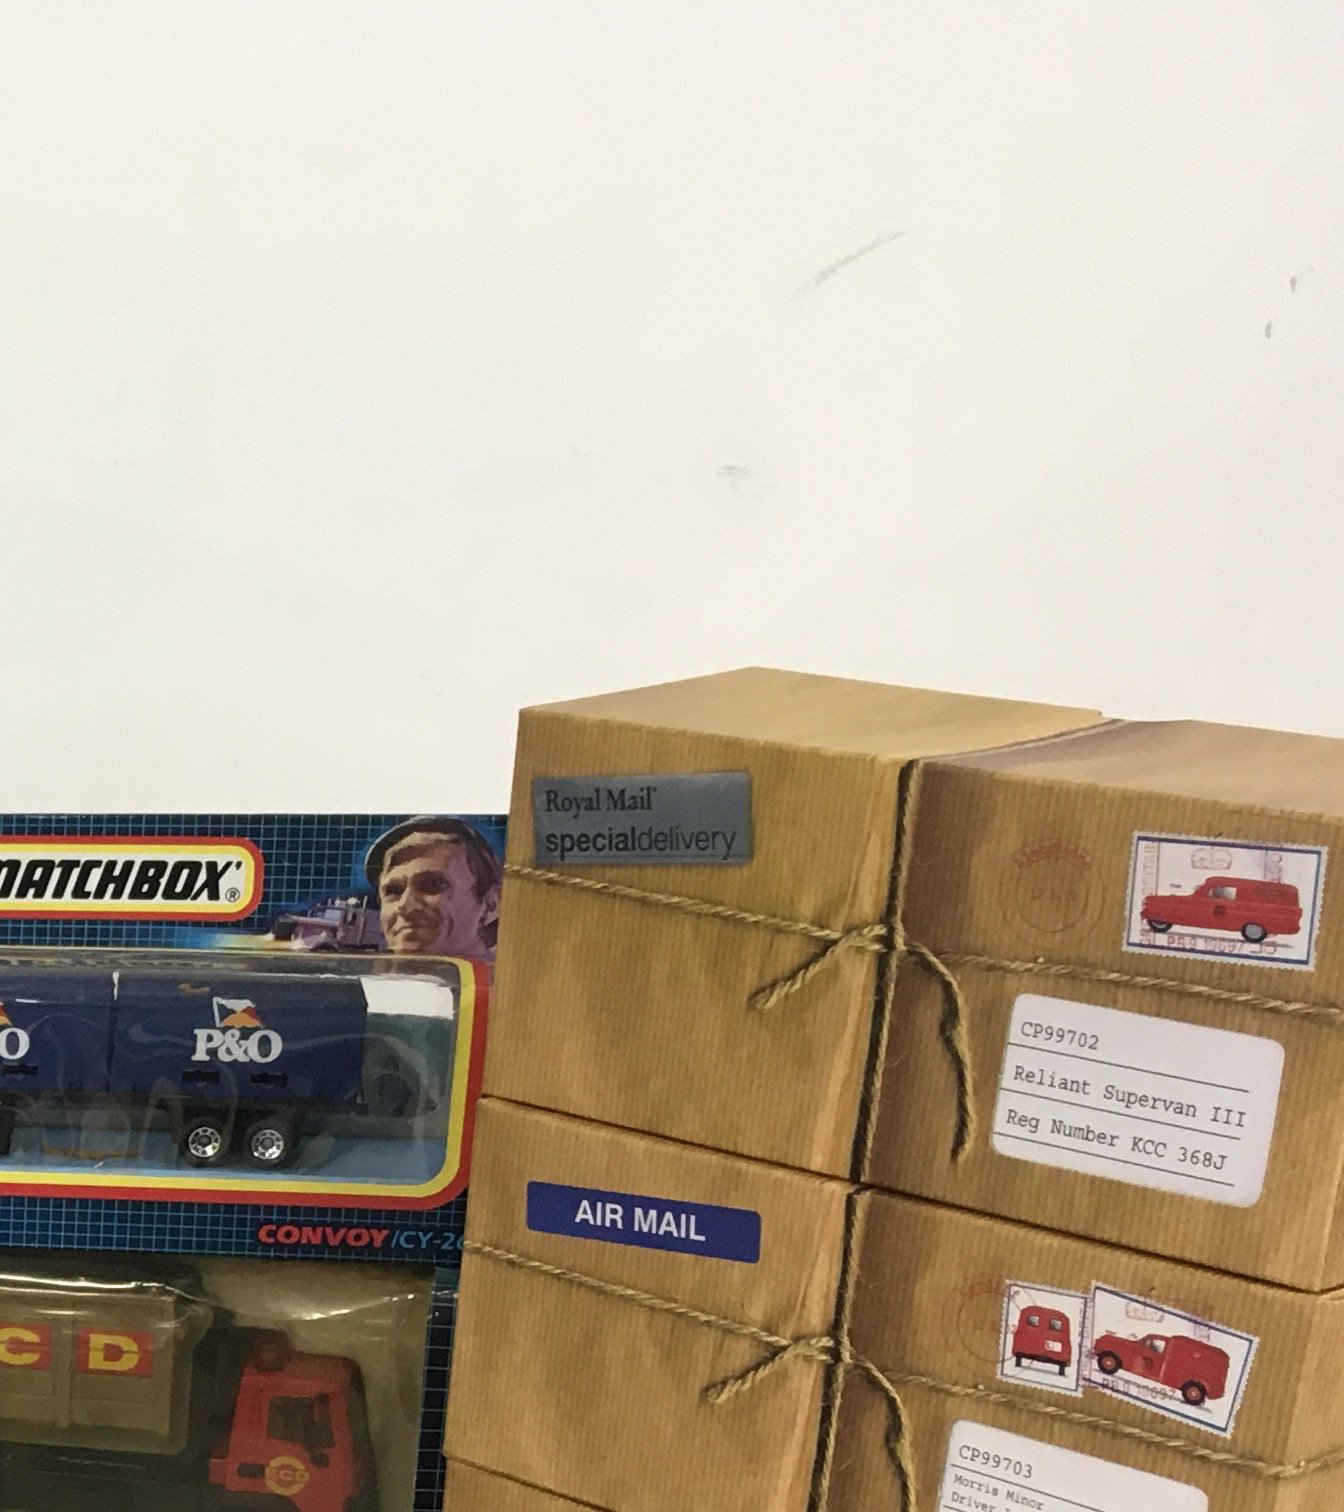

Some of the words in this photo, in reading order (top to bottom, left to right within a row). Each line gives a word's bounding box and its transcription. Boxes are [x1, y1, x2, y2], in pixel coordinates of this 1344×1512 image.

[545, 788, 600, 818] Royal
[606, 786, 652, 810] Mail
[193, 1027, 282, 1063] P&O
[1021, 1022, 1099, 1050] CP99702
[1014, 1065, 1090, 1095] Reliant
[1103, 1084, 1197, 1118] Supervan
[1211, 1106, 1246, 1128] III
[1007, 1109, 1039, 1133] Reg
[1051, 1119, 1119, 1147] Number
[1132, 1137, 1167, 1158] KCC
[1178, 1148, 1228, 1170] 368J
[574, 1198, 623, 1231] AIR
[633, 1205, 705, 1242] MAIL
[959, 1445, 1033, 1478] CP99703
[954, 1473, 999, 1496] Morris
[1006, 1490, 1044, 1511] Minor
